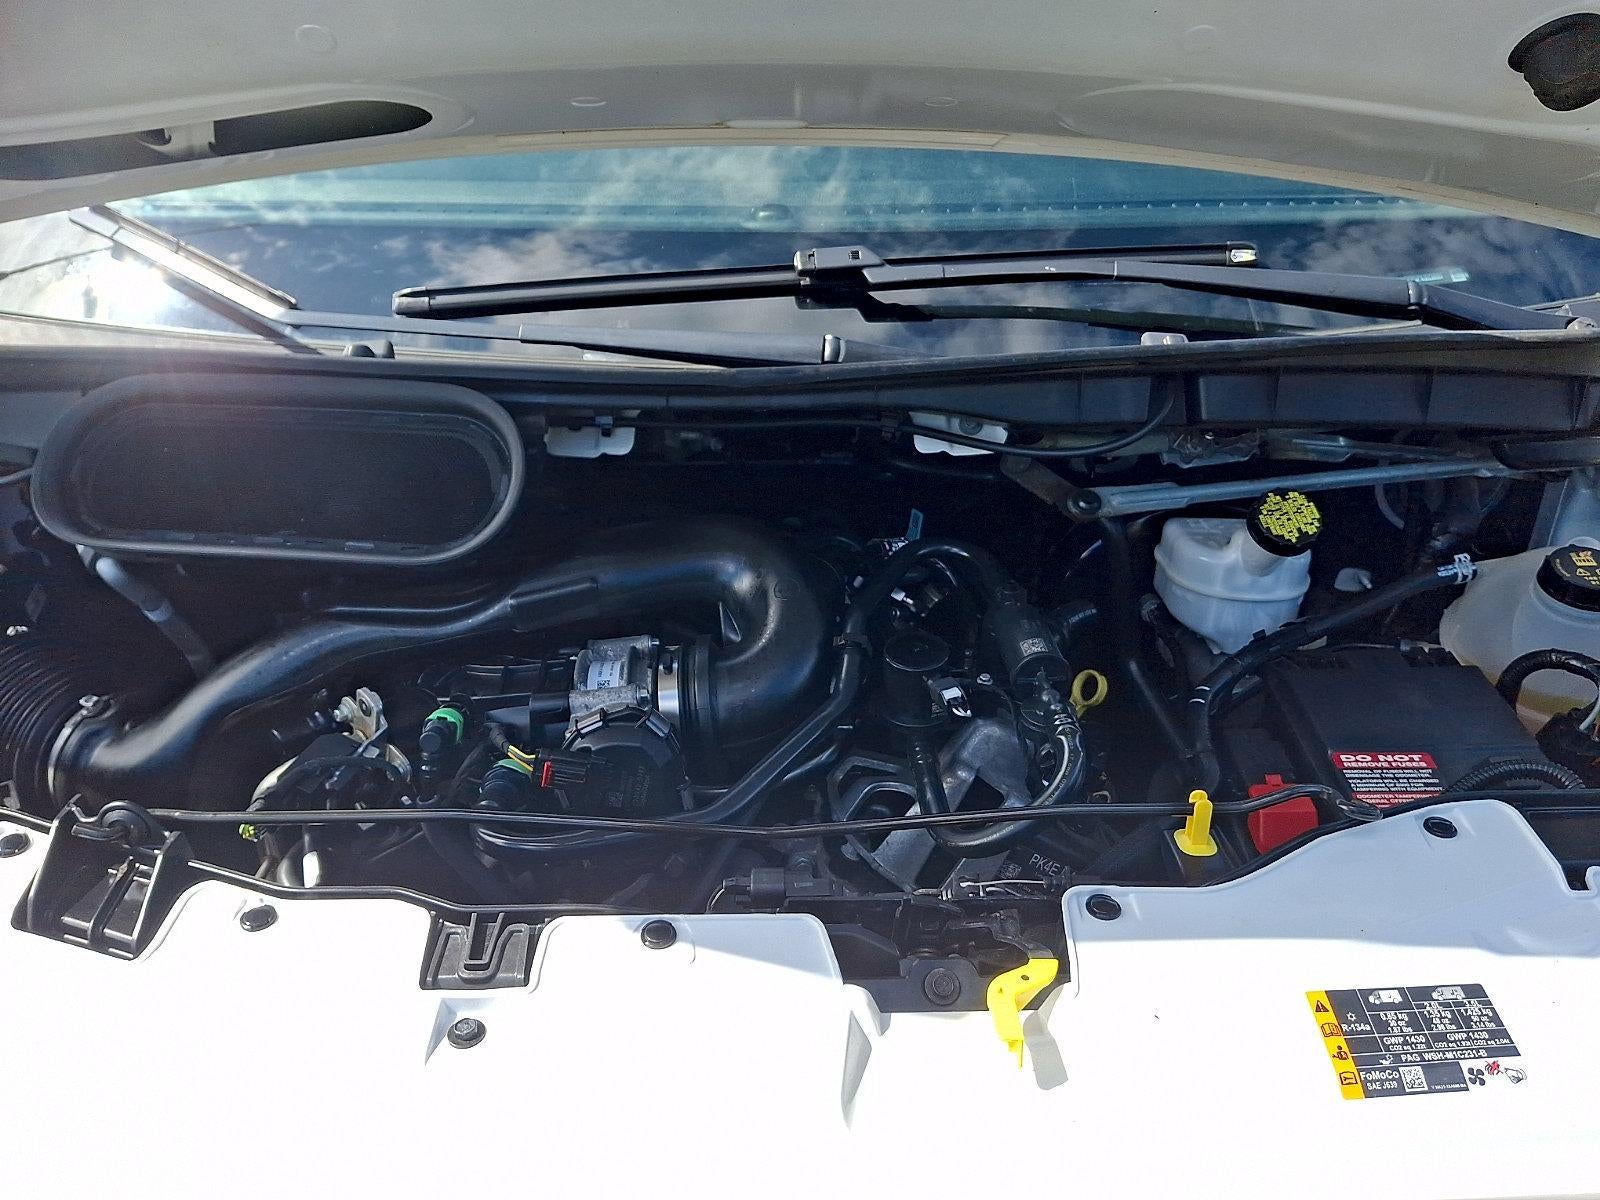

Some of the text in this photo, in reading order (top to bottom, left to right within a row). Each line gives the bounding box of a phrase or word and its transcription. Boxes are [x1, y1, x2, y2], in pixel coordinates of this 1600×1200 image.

[1340, 754, 1422, 762] DO NOT
[1397, 1011, 1409, 1021] kg
[1440, 1009, 1451, 1019] kg
[1481, 1007, 1493, 1017] kg
[1340, 1023, 1371, 1032] R-134a
[1383, 1034, 1425, 1044] GWP 1430
[1446, 1031, 1489, 1041] GWP 1430
[1400, 1049, 1488, 1063] PAG WSH-M1C231-B
[1360, 1069, 1399, 1081] FoMoCo
[1367, 1081, 1398, 1090] SAE J639
